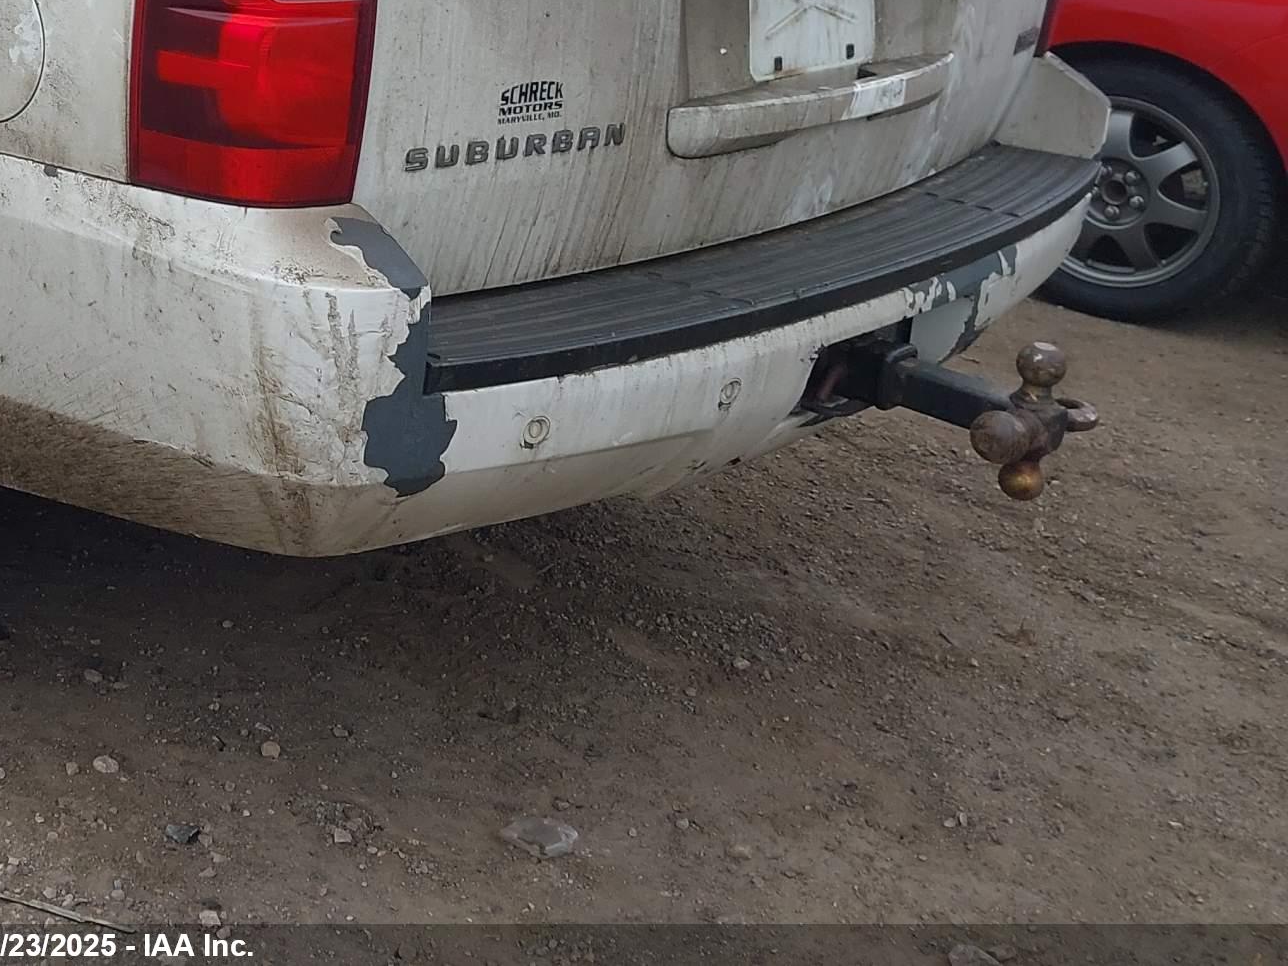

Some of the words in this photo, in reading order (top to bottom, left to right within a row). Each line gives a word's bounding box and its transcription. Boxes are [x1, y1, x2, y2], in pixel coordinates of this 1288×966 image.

[500, 81, 564, 106] SCHRECK
[499, 100, 563, 116] MOTORS
[405, 123, 626, 172] SUBURBAN
